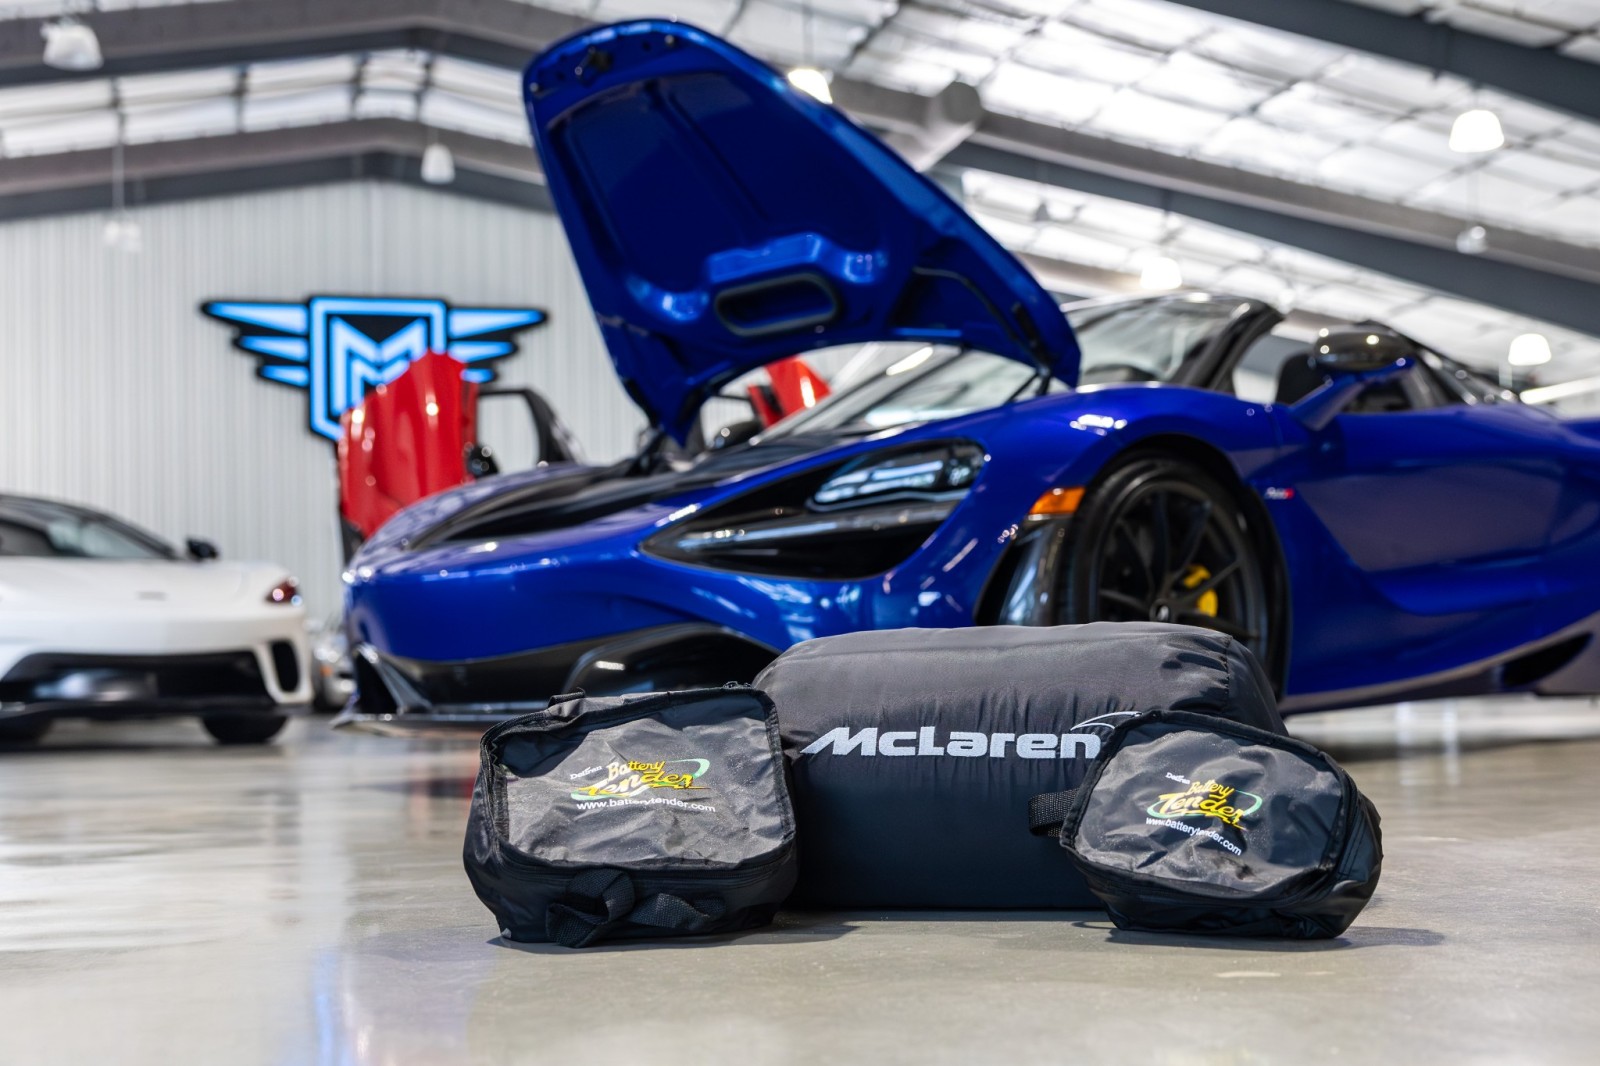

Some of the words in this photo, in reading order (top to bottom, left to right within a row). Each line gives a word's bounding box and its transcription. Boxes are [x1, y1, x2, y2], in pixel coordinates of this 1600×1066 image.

[800, 725, 1101, 760] McLaren
[606, 760, 666, 782] Battery
[1186, 779, 1235, 800] Battery
[576, 797, 716, 813] www.batterytender.com
[1158, 791, 1245, 825] Tender
[1145, 817, 1242, 856] www.batterytender.com
